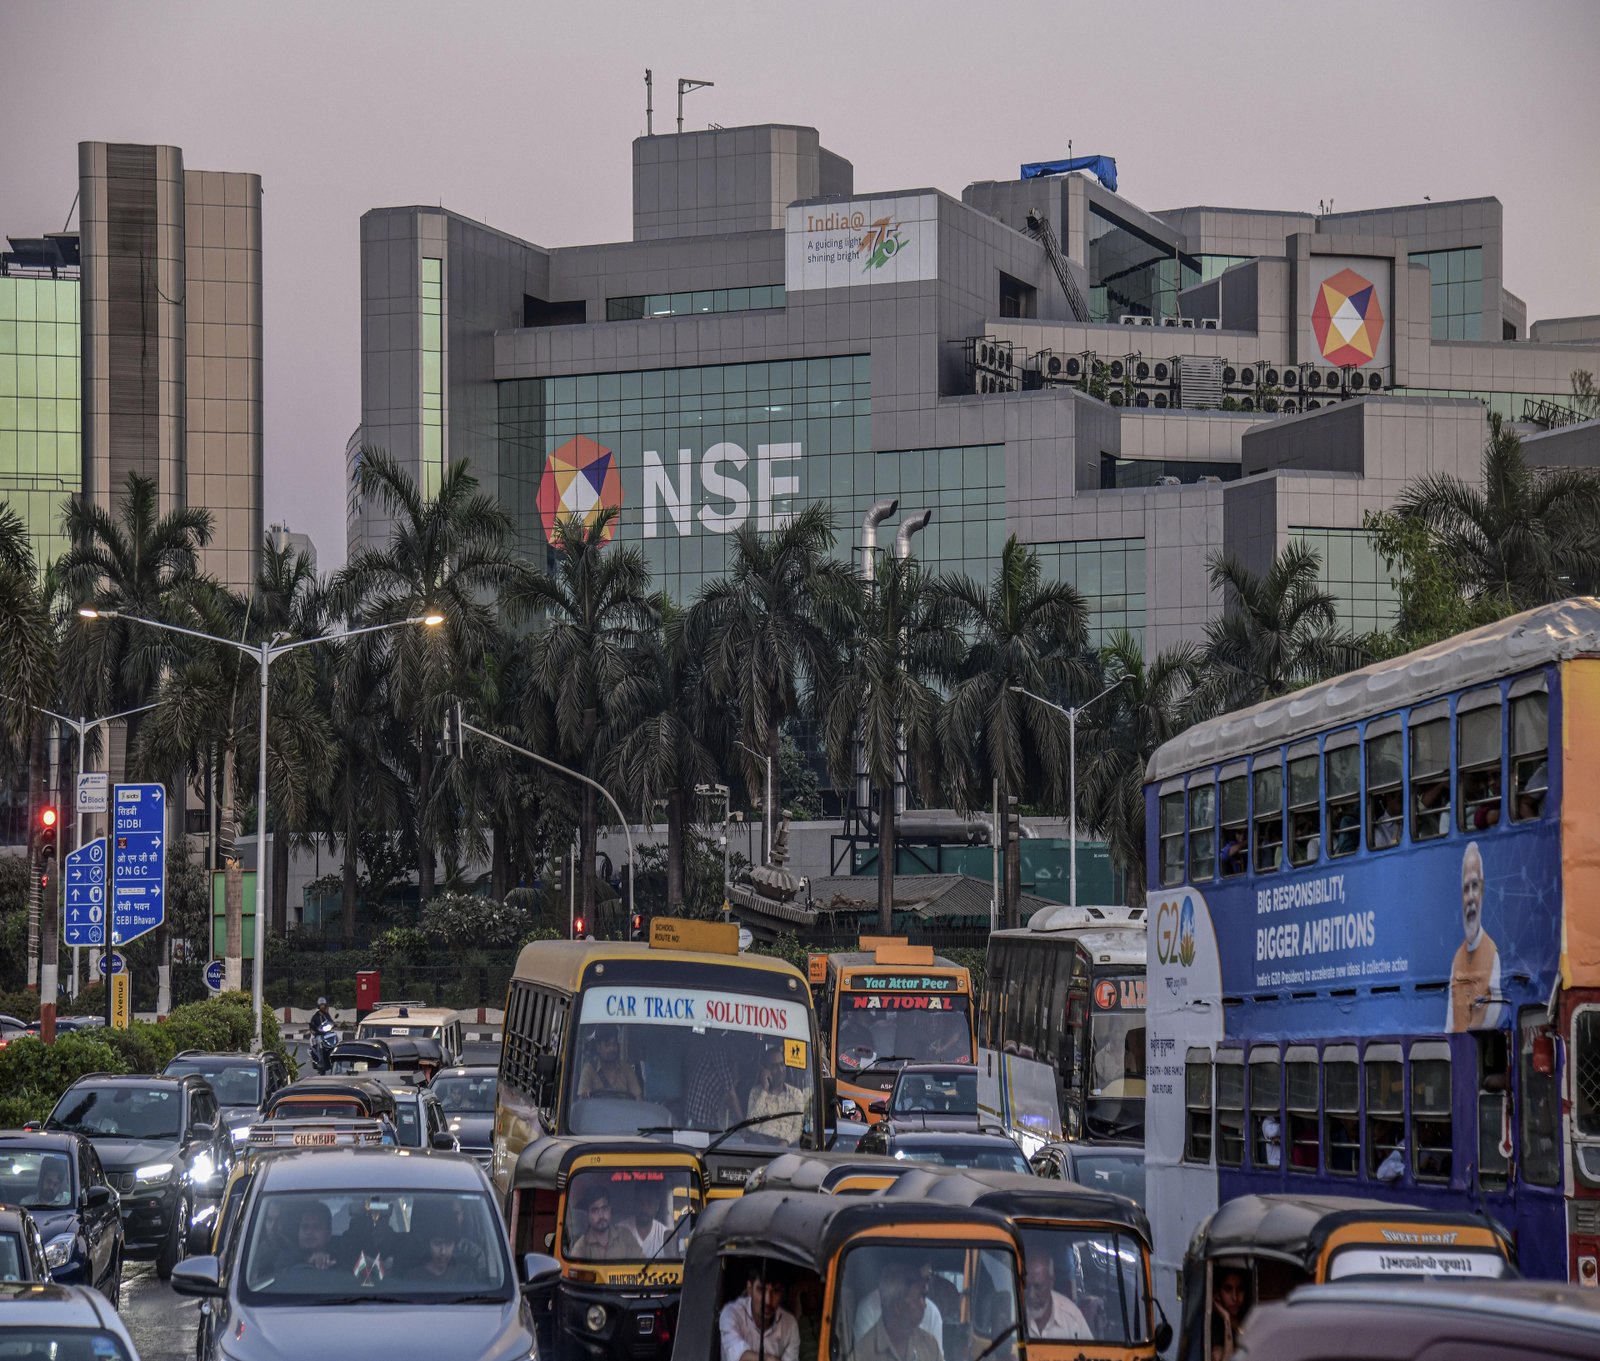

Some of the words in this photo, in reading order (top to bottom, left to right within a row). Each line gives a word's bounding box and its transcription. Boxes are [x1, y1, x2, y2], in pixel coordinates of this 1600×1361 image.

[808, 240, 813, 250] A
[816, 238, 843, 251] guiding
[807, 251, 835, 264] shining
[837, 250, 860, 263] bright
[643, 442, 802, 538] NSE
[117, 819, 142, 829] SIDBI
[138, 852, 147, 863] जी
[149, 852, 158, 862] सी
[117, 866, 148, 876] ONGC
[1257, 889, 1272, 914] BIG
[1273, 874, 1345, 912] RESPONSIBILITY,
[133, 902, 150, 911] भवन
[116, 916, 132, 925] SEBI
[133, 915, 155, 924] Bhavan
[654, 933, 671, 942] ROUTE
[1256, 924, 1299, 961] BIGGER
[1302, 910, 1375, 955] AMBITIONS
[1257, 973, 1271, 986] India's
[1271, 972, 1281, 985] G20
[1282, 969, 1304, 985] Presidency
[1305, 970, 1310, 981] to
[1311, 966, 1335, 981] accelerate
[1336, 967, 1346, 977] new
[1347, 962, 1360, 976] ideas
[1366, 958, 1391, 974] collective
[1391, 956, 1408, 972] action
[864, 976, 885, 989] Yaa
[888, 977, 919, 989] Attar
[921, 976, 949, 989] Peer
[116, 981, 124, 1017] Avenue
[853, 996, 952, 1009] NATIONAL
[606, 994, 636, 1017] CAR
[644, 996, 694, 1019] TRACK
[705, 999, 787, 1030] SOLUTIONS
[294, 1133, 337, 1146] CHEMBUR
